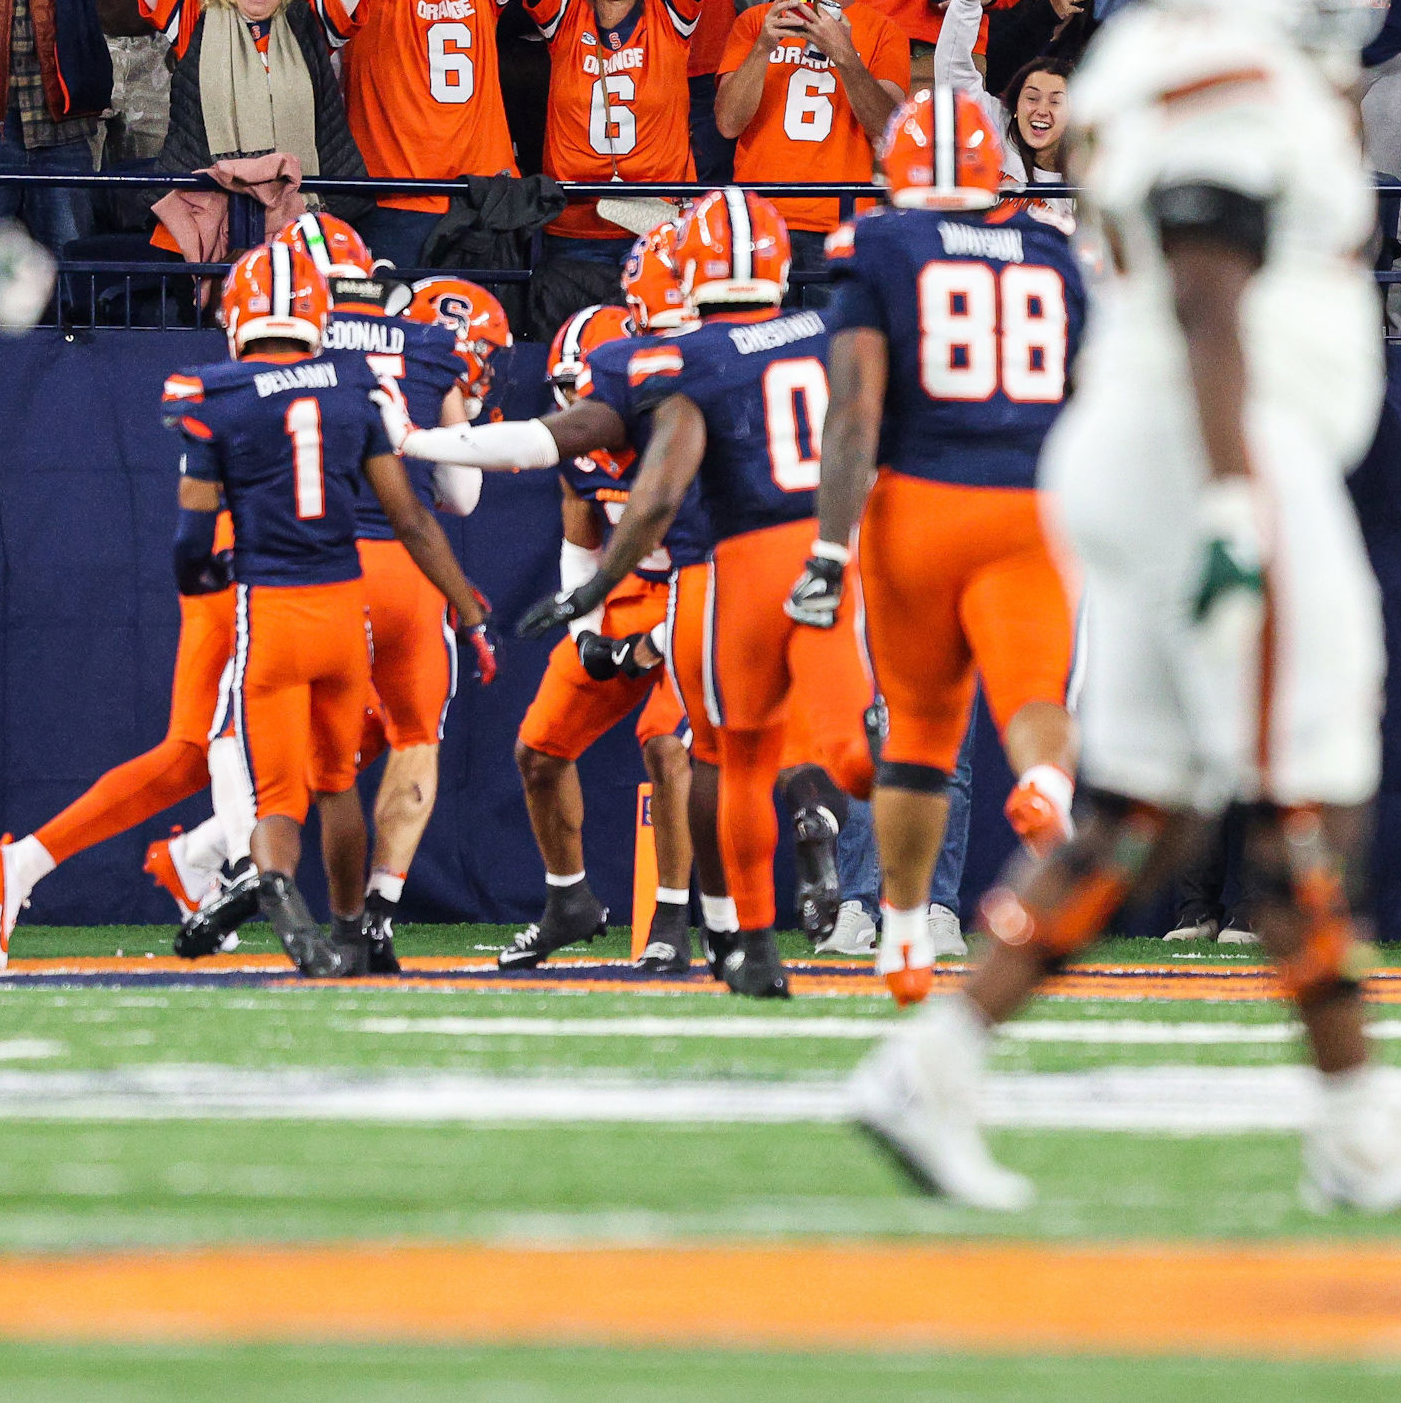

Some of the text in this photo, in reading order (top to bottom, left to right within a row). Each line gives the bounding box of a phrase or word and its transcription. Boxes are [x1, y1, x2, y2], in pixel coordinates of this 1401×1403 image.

[427, 21, 474, 104] 6
[582, 47, 645, 77] ORANGE
[608, 31, 623, 51] S
[588, 74, 636, 156] 6
[782, 66, 837, 144] 6
[916, 258, 1068, 405] 88
[286, 395, 326, 520] 1
[762, 354, 829, 493] 0
